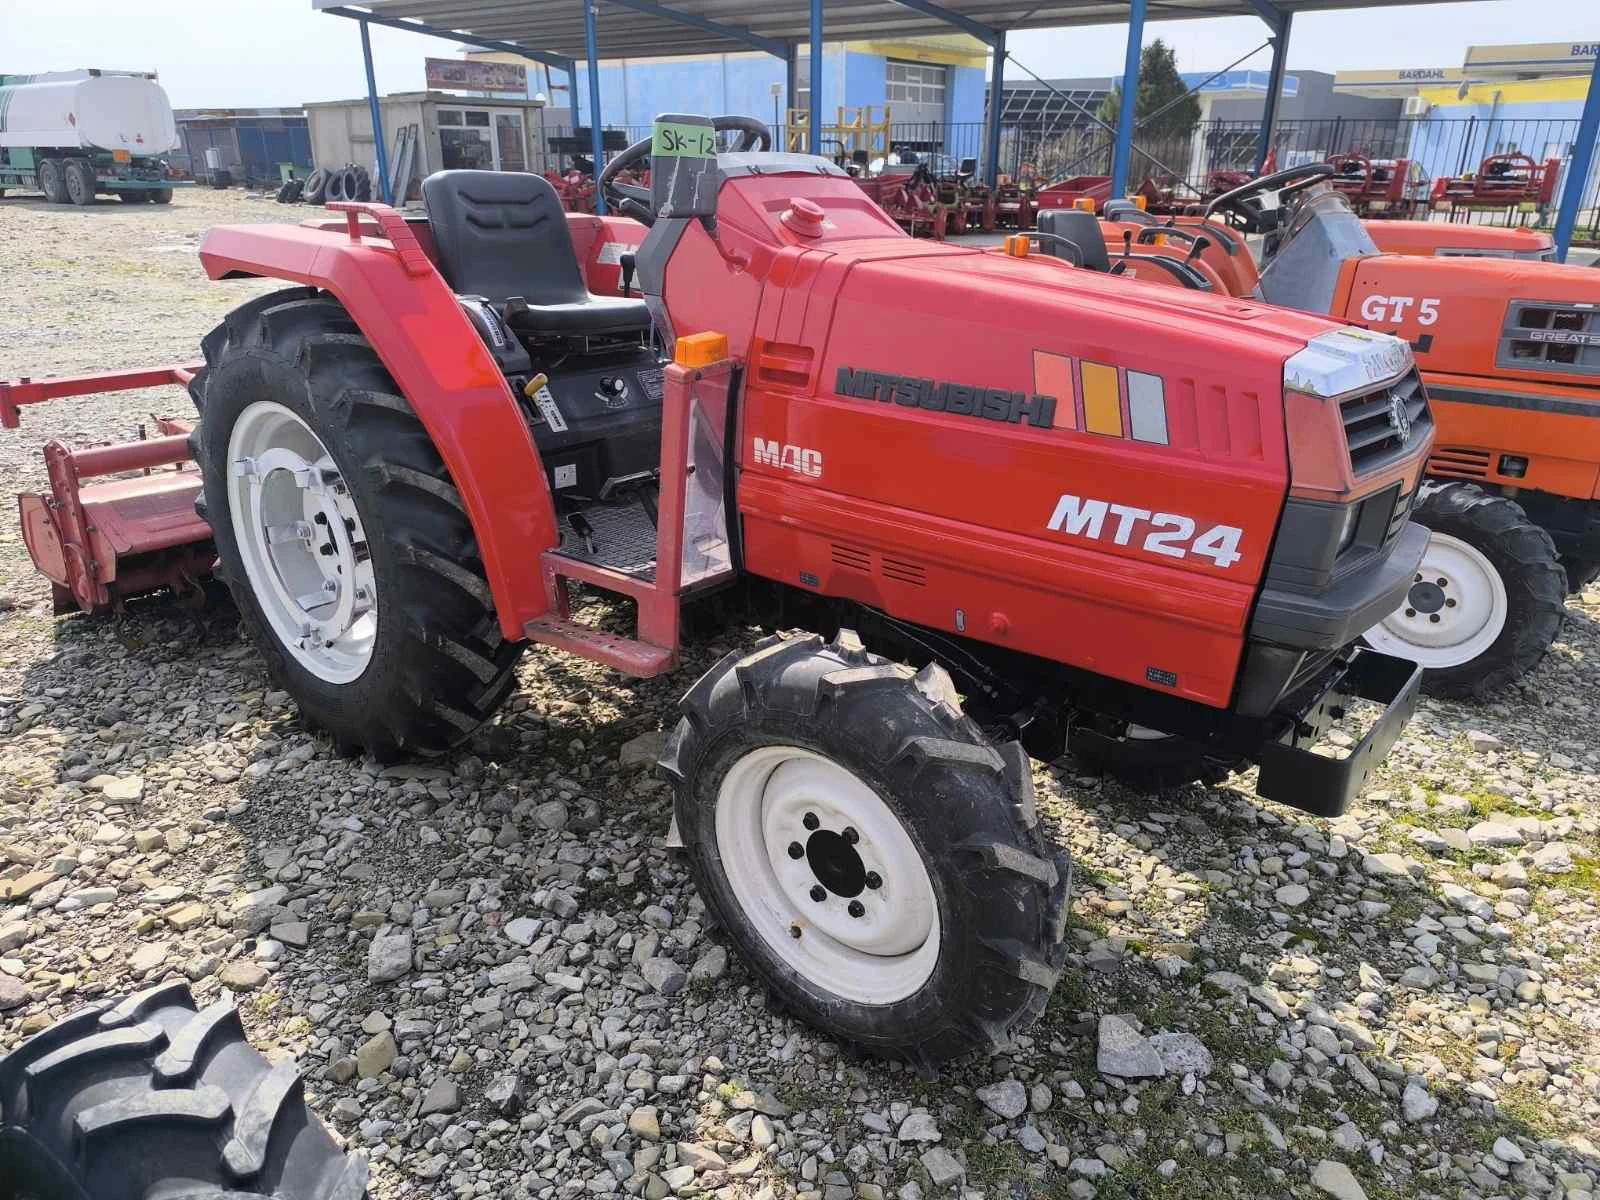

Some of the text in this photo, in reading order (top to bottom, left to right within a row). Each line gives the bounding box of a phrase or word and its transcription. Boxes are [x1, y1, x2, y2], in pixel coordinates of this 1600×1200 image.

[1399, 69, 1444, 79] BARDAHL
[1361, 295, 1441, 326] GT 5
[834, 366, 1057, 429] MITSUBISHI
[753, 436, 822, 478] MAC
[1046, 494, 1243, 569] MT24
